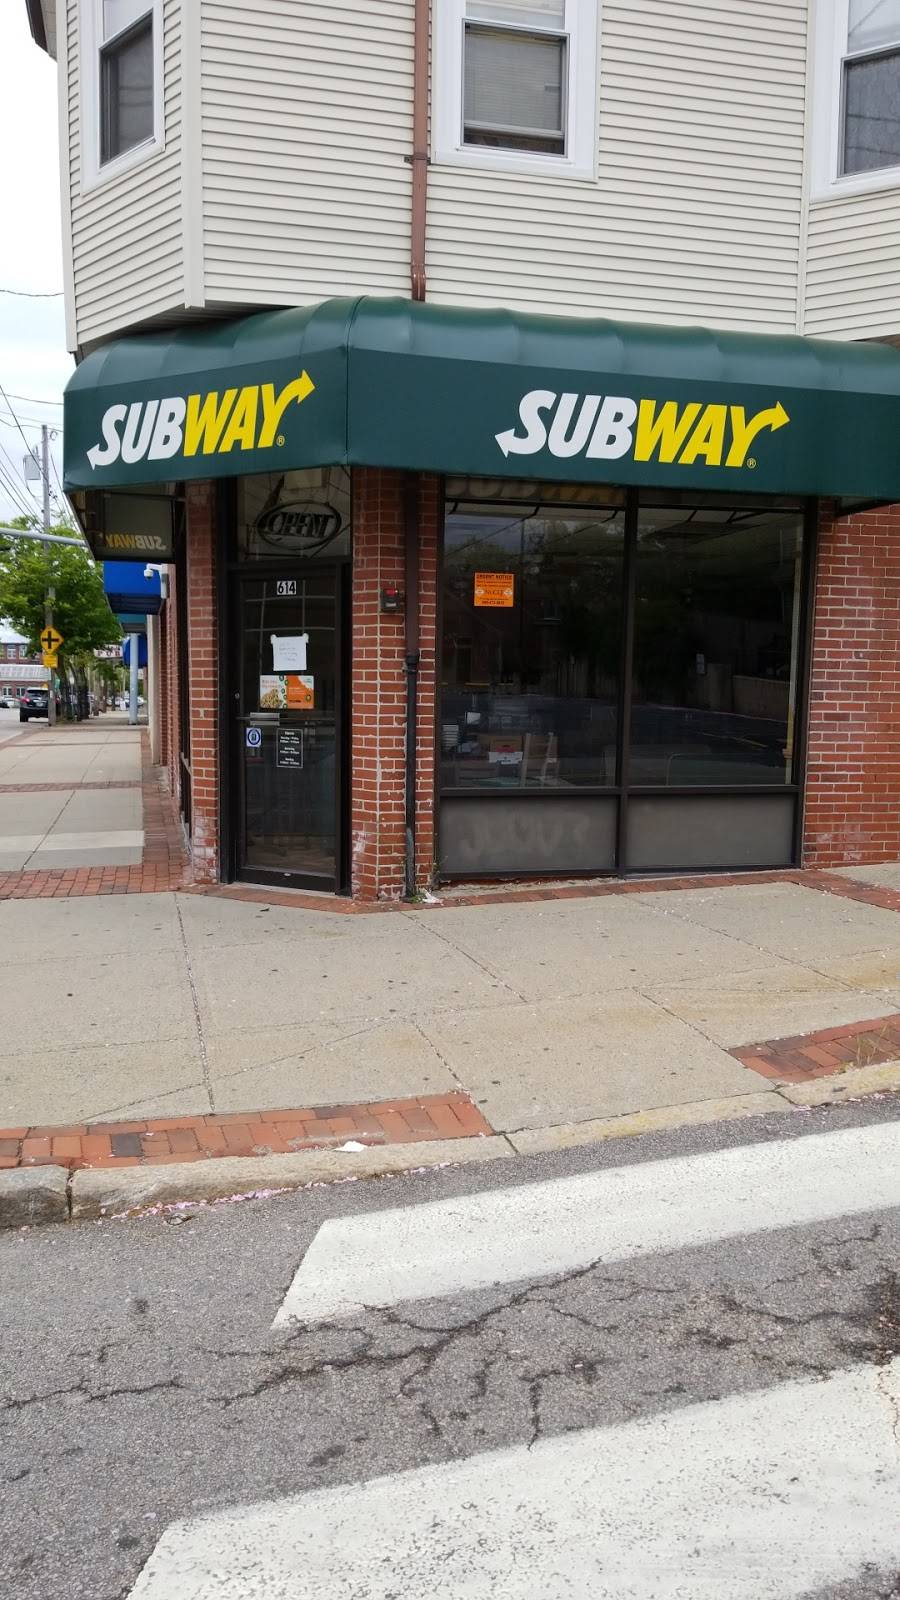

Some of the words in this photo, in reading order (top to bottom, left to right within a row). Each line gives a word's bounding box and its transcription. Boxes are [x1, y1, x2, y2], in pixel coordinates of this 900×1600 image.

[86, 369, 315, 470] SUBWAY
[495, 389, 790, 468] SUBWAY
[267, 511, 334, 538] OPEN
[278, 580, 296, 594] 614
